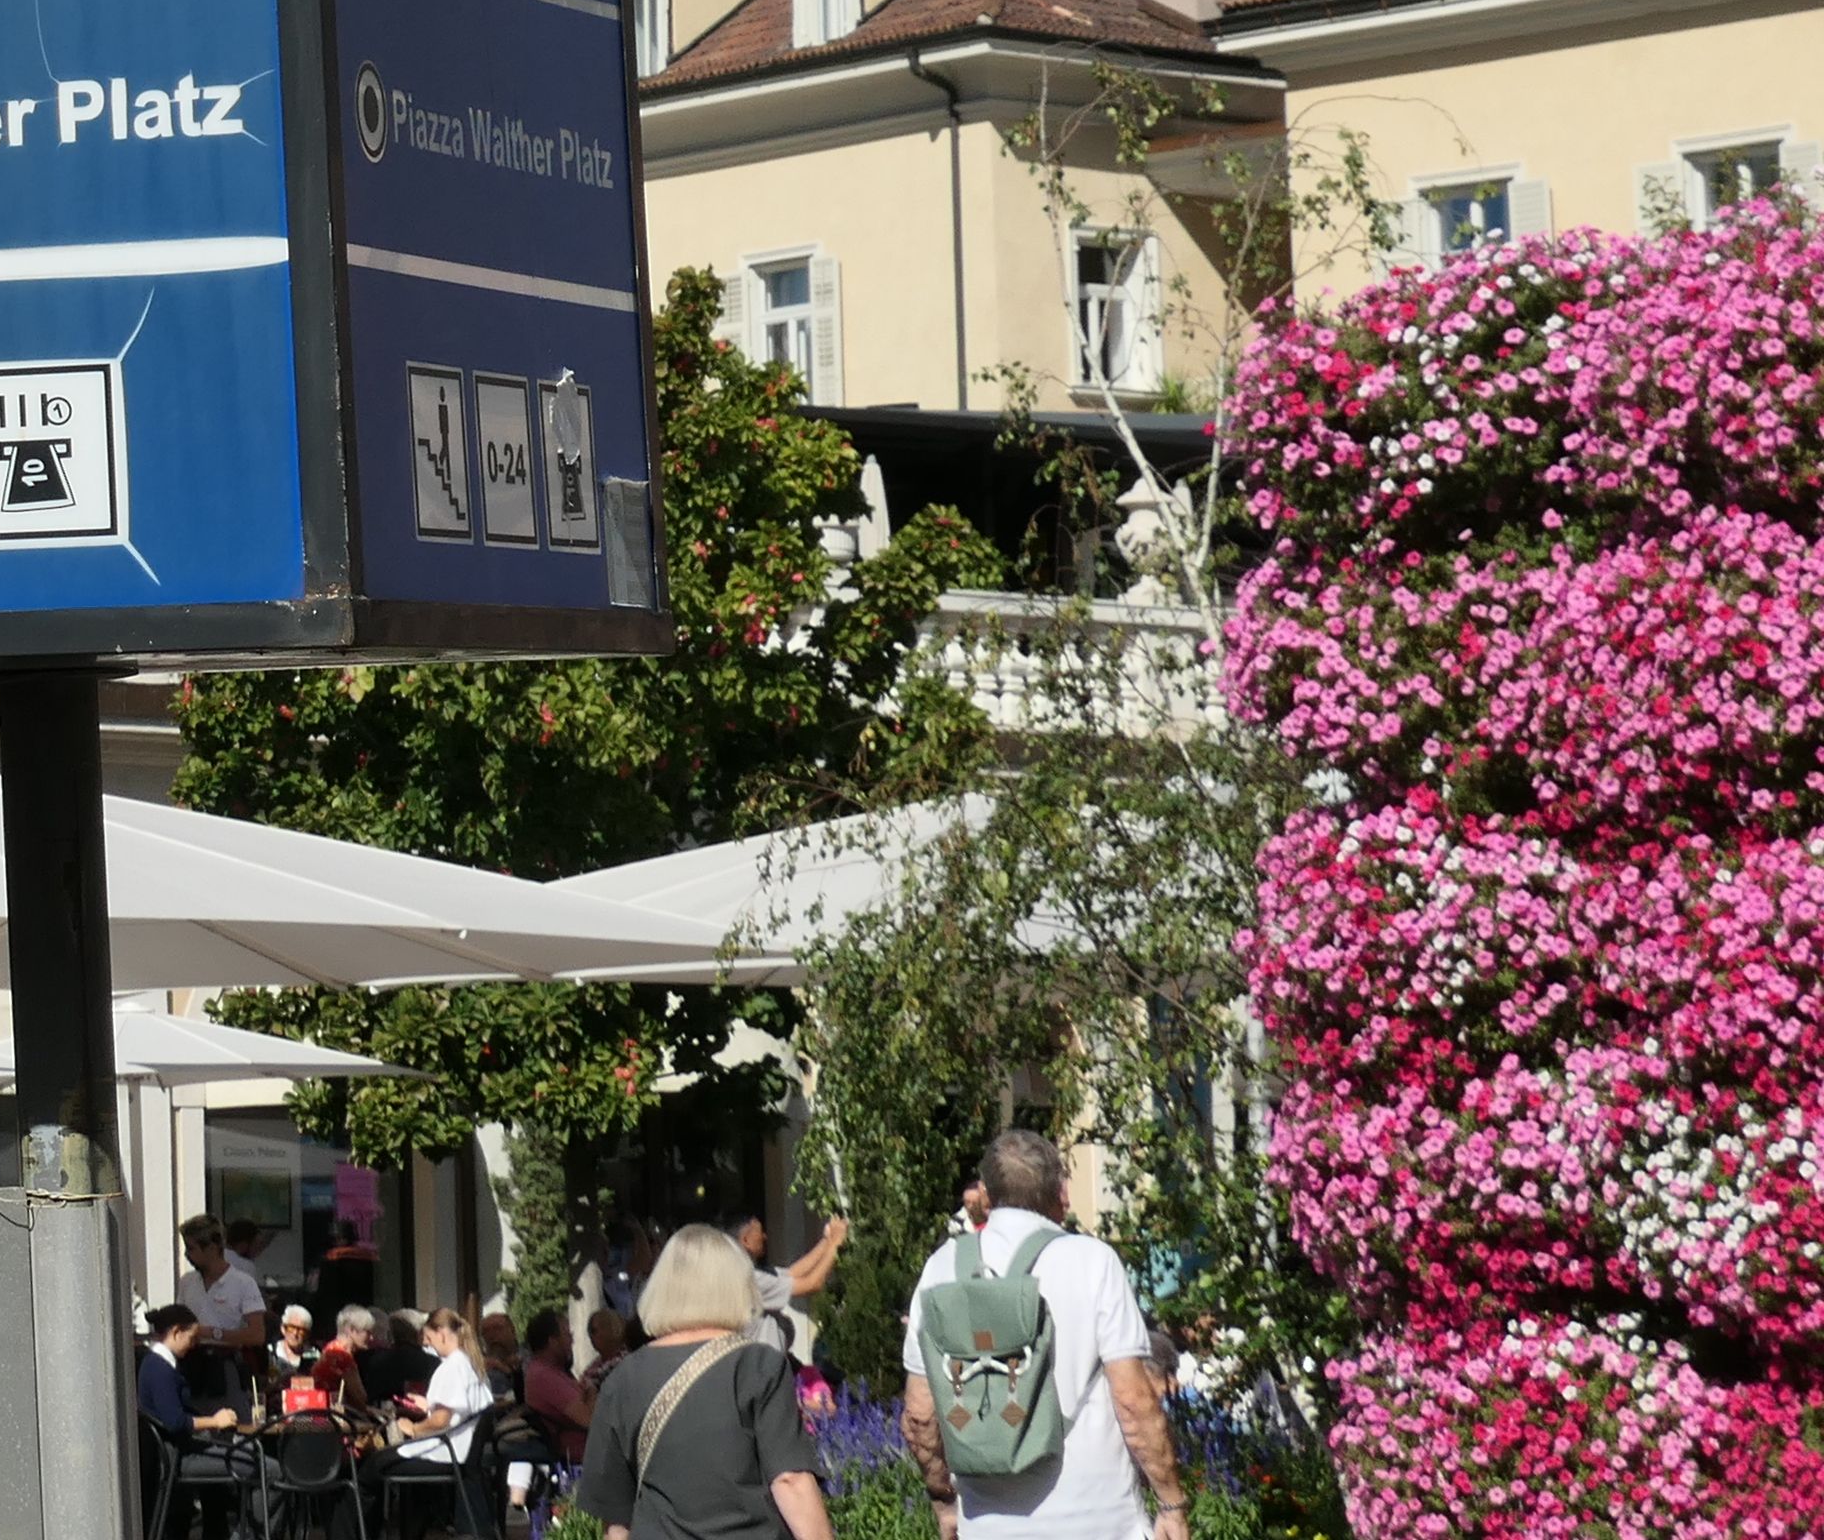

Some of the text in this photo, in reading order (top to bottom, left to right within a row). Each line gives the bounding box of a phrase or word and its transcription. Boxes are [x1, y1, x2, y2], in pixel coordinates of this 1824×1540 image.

[56, 72, 244, 144] Platz
[392, 88, 613, 190] Piazza Walther Platz
[487, 440, 526, 486] 0-24
